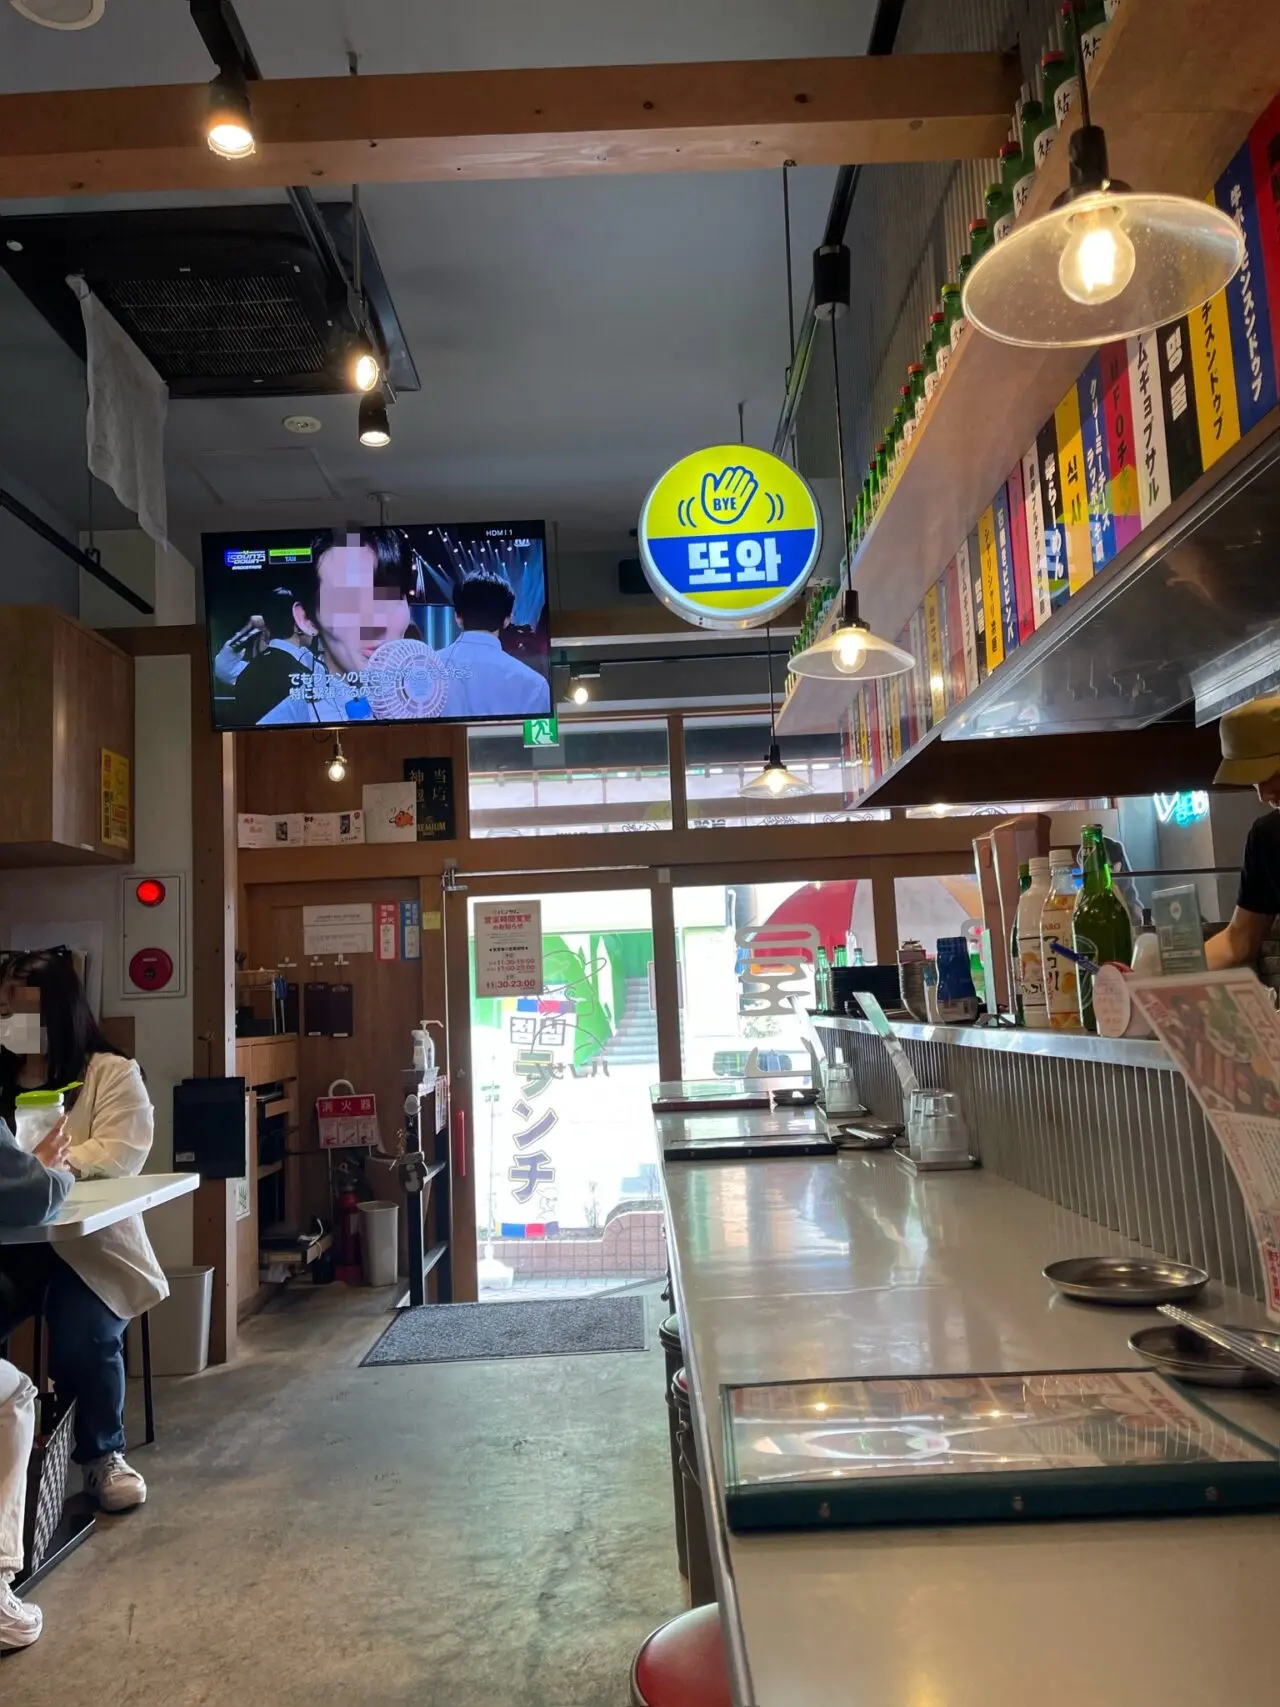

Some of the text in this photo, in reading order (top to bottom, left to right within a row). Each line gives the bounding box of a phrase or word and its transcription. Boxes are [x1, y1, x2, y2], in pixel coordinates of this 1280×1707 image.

[713, 497, 737, 511] BYE
[687, 537, 782, 585] 또와
[509, 1049, 558, 1204] ランチ
